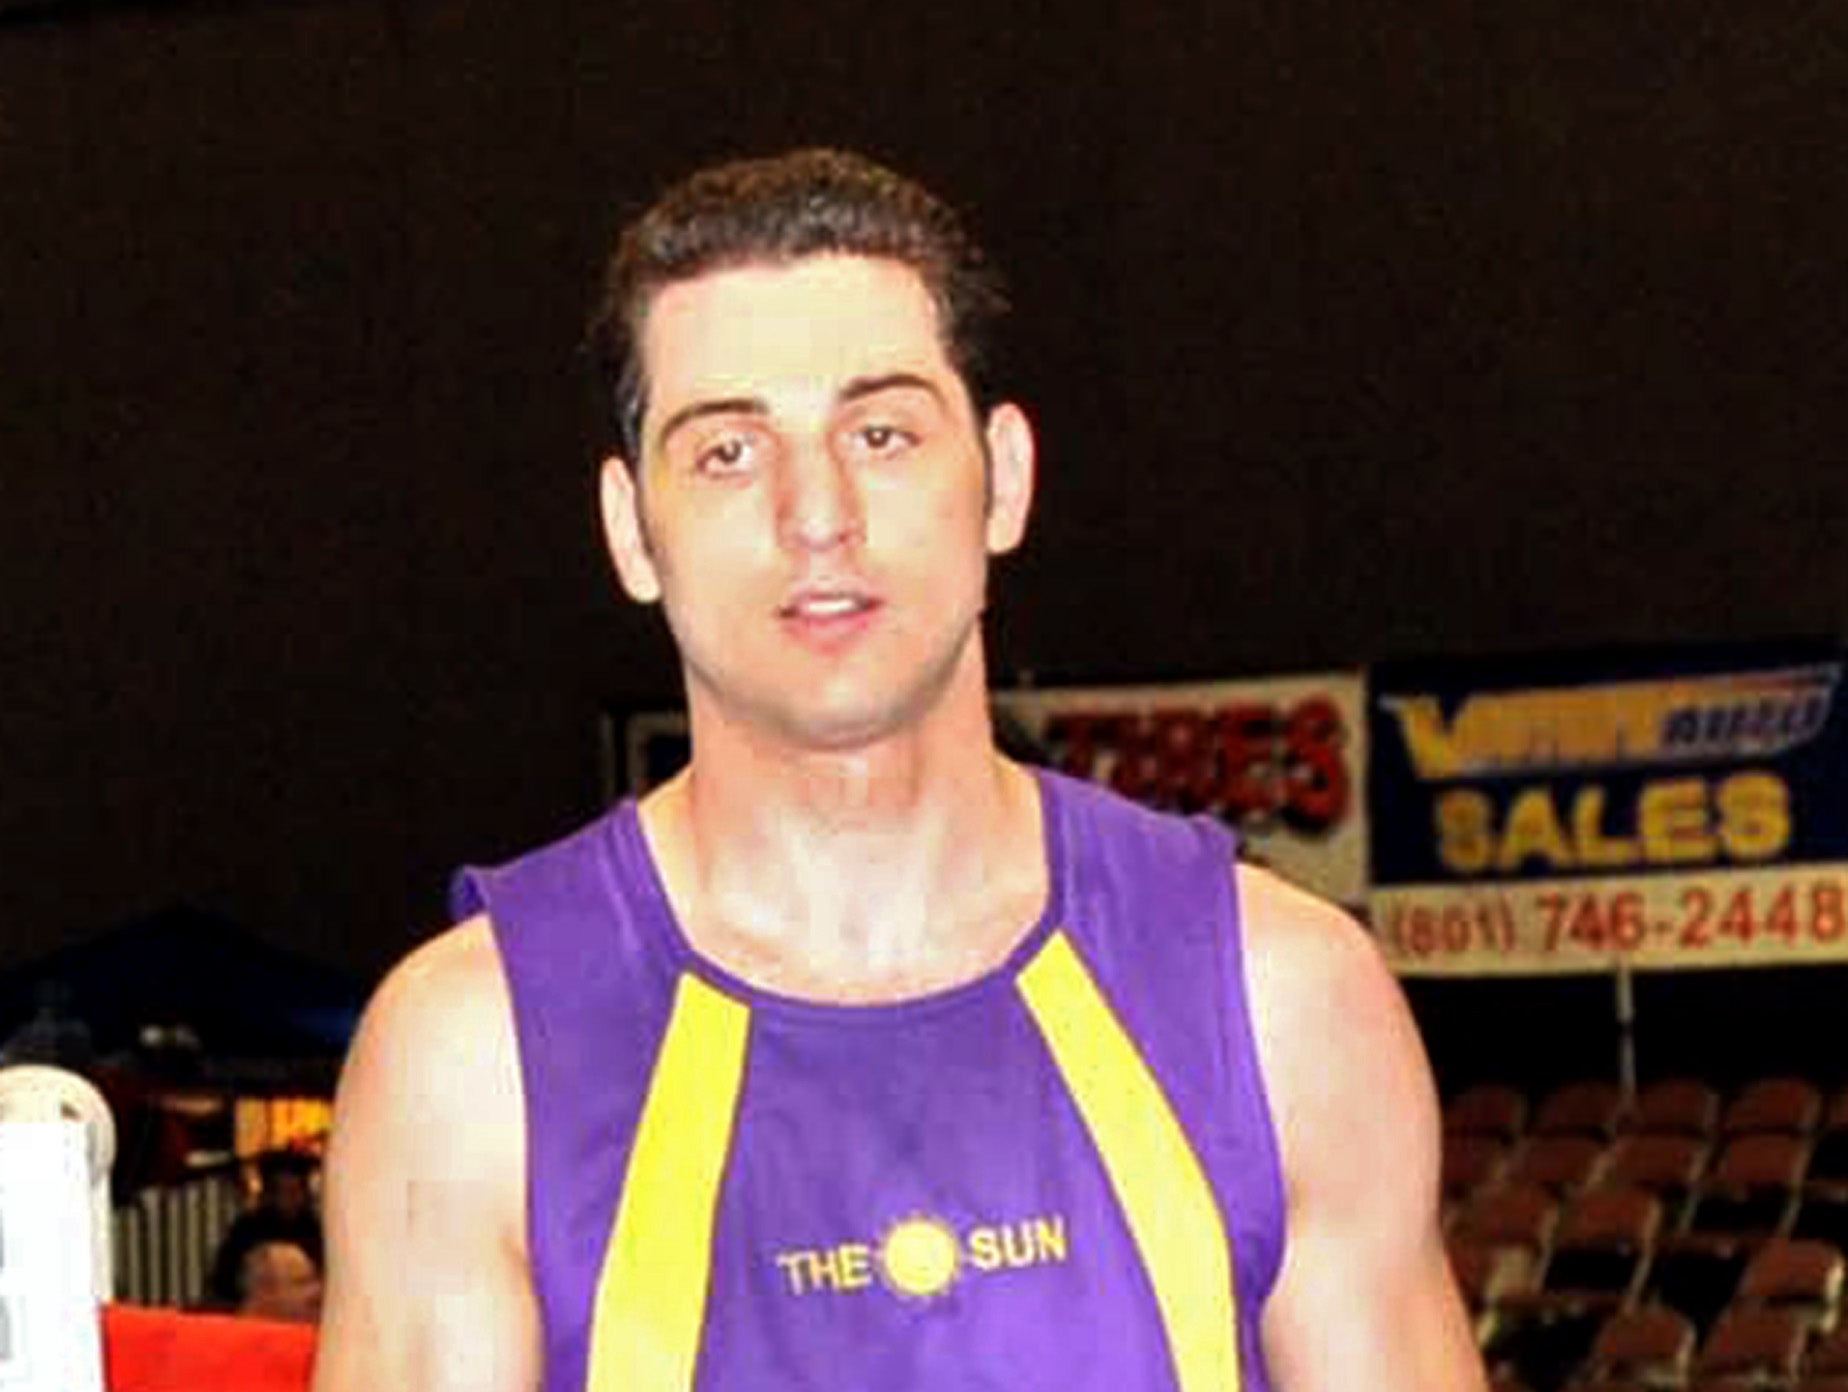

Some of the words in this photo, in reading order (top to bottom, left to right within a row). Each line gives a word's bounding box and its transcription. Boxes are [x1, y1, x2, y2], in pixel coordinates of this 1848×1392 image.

[1436, 772, 1793, 873] SALES
[1534, 880, 1847, 952] 746-2448
[776, 1243, 870, 1297] THE
[967, 1215, 1067, 1271] SUN
